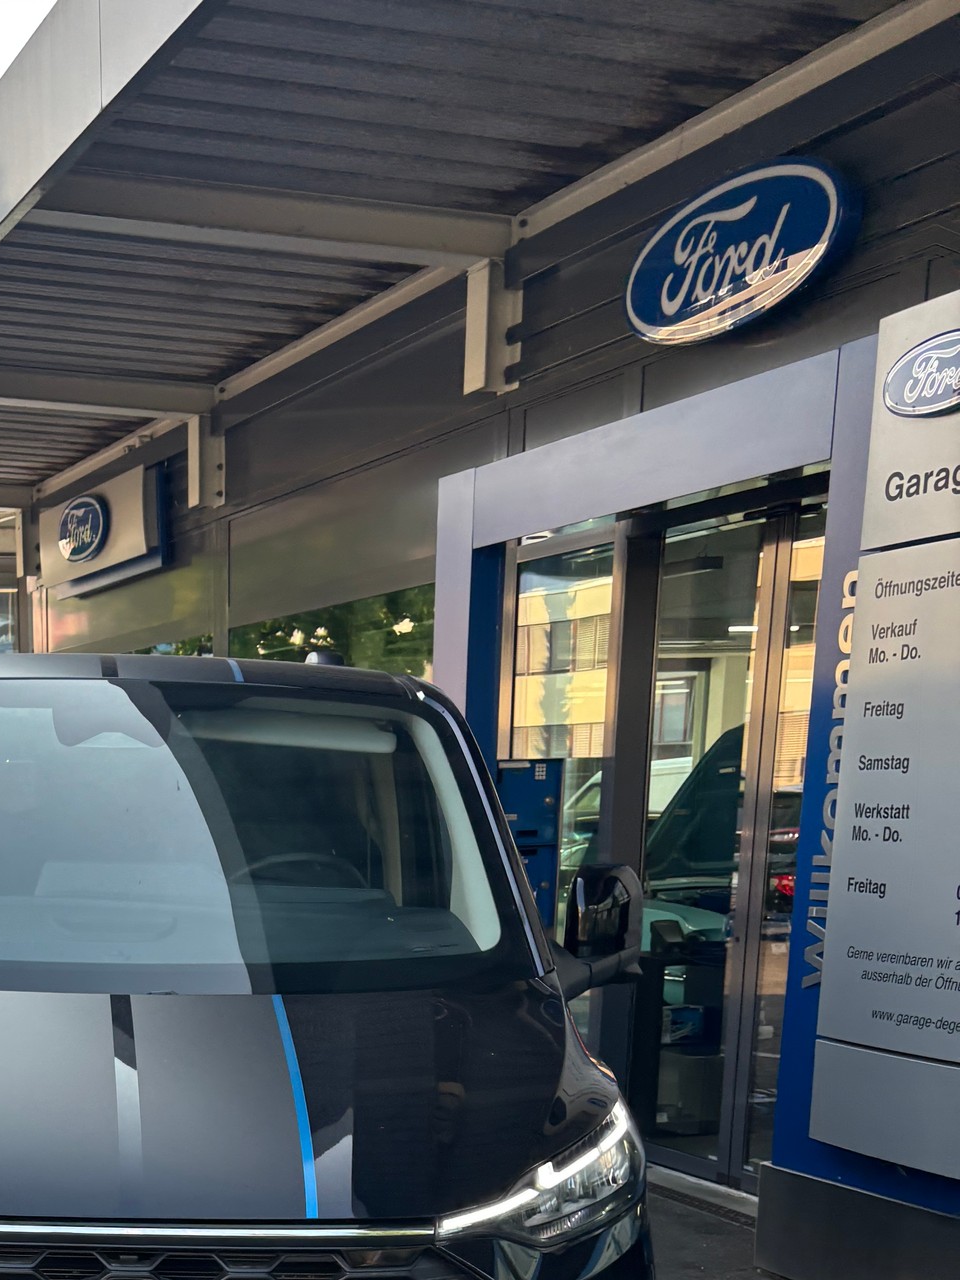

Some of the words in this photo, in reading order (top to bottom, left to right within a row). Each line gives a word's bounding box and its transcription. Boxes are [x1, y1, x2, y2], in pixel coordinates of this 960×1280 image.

[660, 195, 791, 317] Ford
[871, 618, 918, 641] Verkauf
[868, 647, 889, 664] Mo.
[900, 644, 921, 660] Do.
[863, 700, 905, 720] Freitag
[858, 754, 910, 774] Samstag
[854, 803, 910, 820] Werkstatt
[851, 825, 872, 841] Mo.
[882, 826, 902, 842] Do.
[847, 877, 887, 899] Freitag
[846, 945, 874, 961] Gerne
[876, 951, 934, 968] vereinbaren
[936, 956, 954, 970] wir
[860, 969, 913, 986] ausserhalb
[914, 974, 933, 988] der
